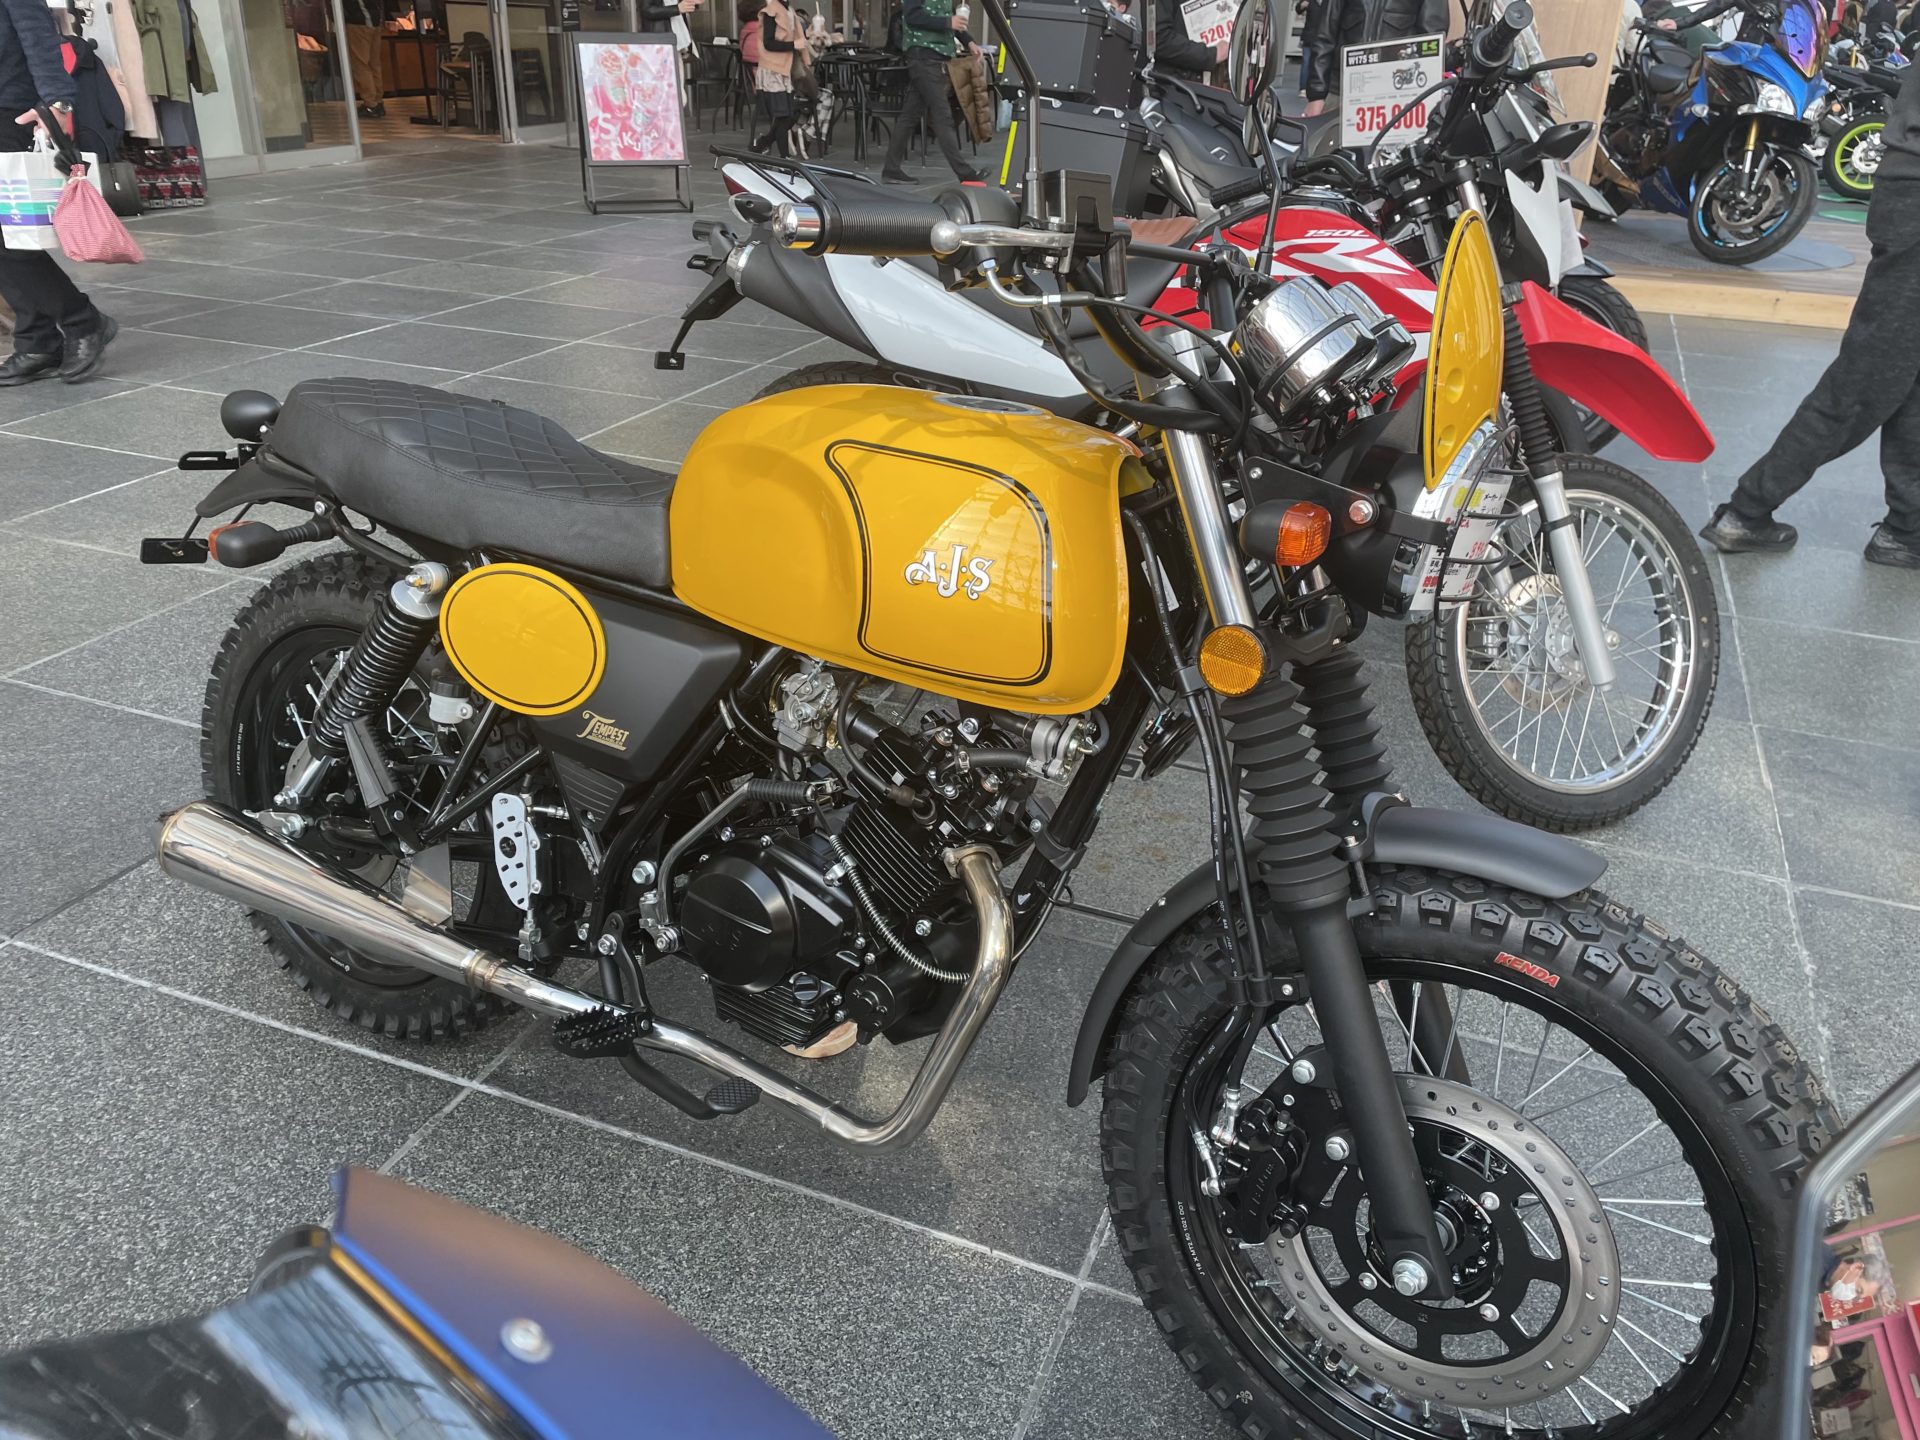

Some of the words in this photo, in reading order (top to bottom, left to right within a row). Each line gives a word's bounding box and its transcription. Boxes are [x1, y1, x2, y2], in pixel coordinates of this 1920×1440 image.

[1348, 54, 1367, 66] W175
[1368, 53, 1379, 63] SE
[576, 710, 630, 742] TEMPEST
[1494, 951, 1560, 988] KENDA
[1177, 1200, 1185, 1216] DOT
